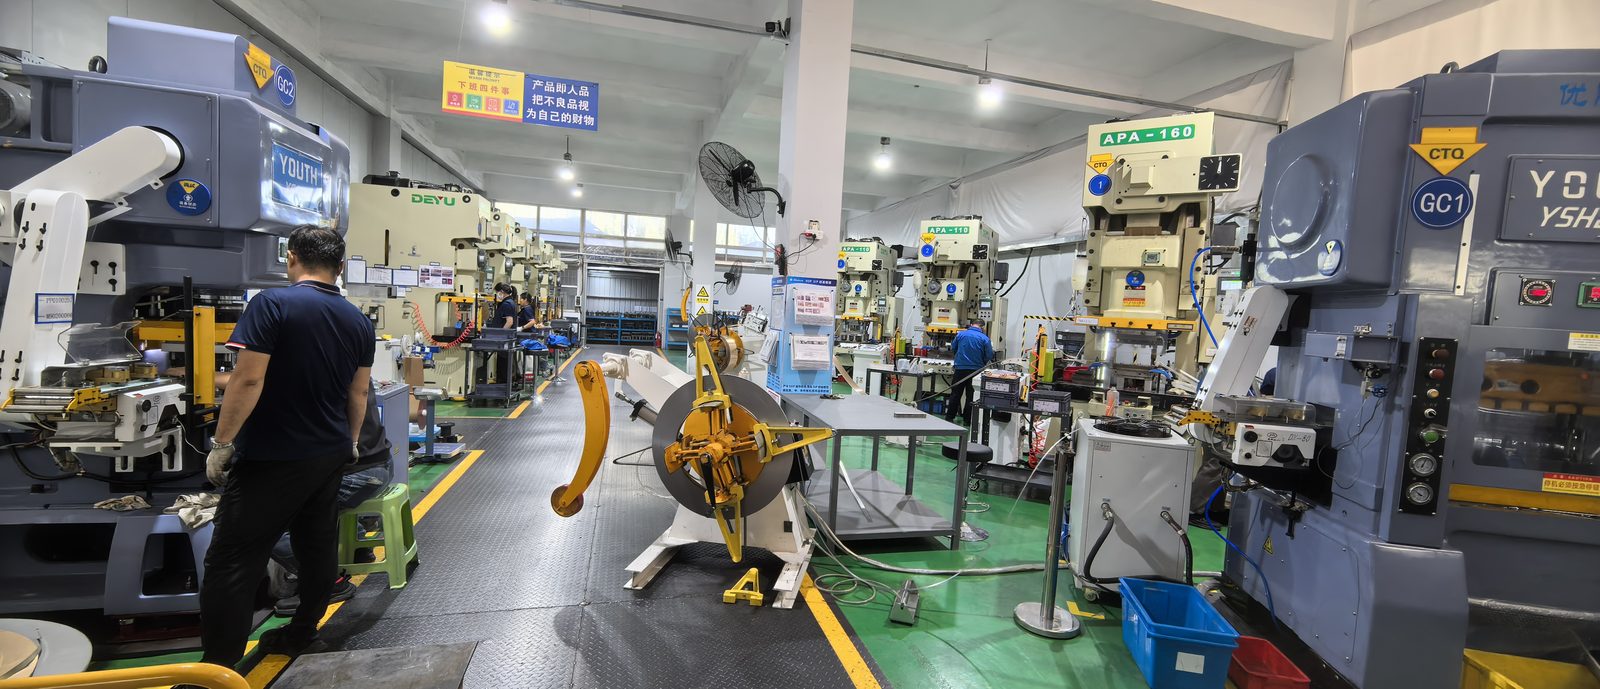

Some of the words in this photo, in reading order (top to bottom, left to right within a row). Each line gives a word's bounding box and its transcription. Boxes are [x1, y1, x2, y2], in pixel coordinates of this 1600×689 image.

[278, 75, 294, 99] GC2
[458, 80, 510, 96] 下班四件事
[532, 79, 590, 97] 产品即人品
[532, 94, 590, 112] 把不良品视
[526, 108, 595, 126] 为自己的财物
[1429, 148, 1464, 160] CTQ
[280, 153, 318, 186] YOUTH
[1530, 170, 1600, 199] YO
[411, 193, 456, 207] DEYU
[1420, 192, 1464, 214] GC1
